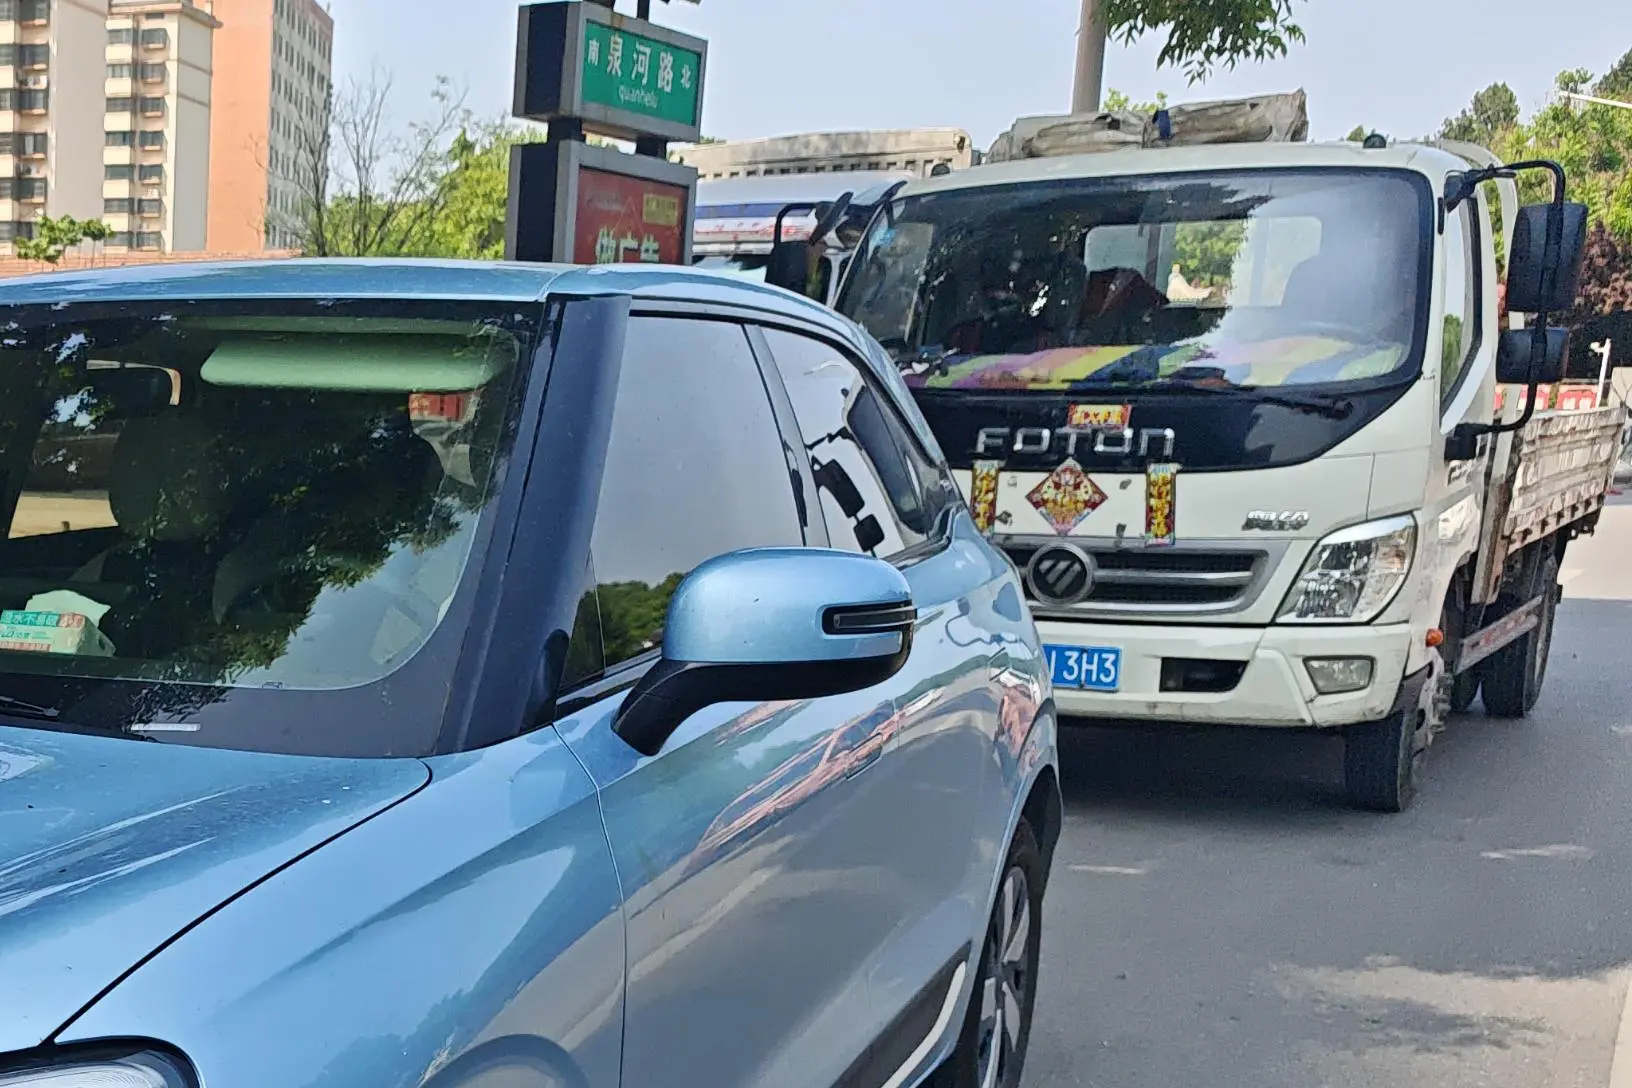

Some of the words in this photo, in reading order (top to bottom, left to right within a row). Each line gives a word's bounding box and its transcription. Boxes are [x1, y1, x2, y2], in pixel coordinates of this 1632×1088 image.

[588, 38, 600, 66] 南
[606, 33, 674, 93] 泉河路
[680, 64, 692, 89] 北
